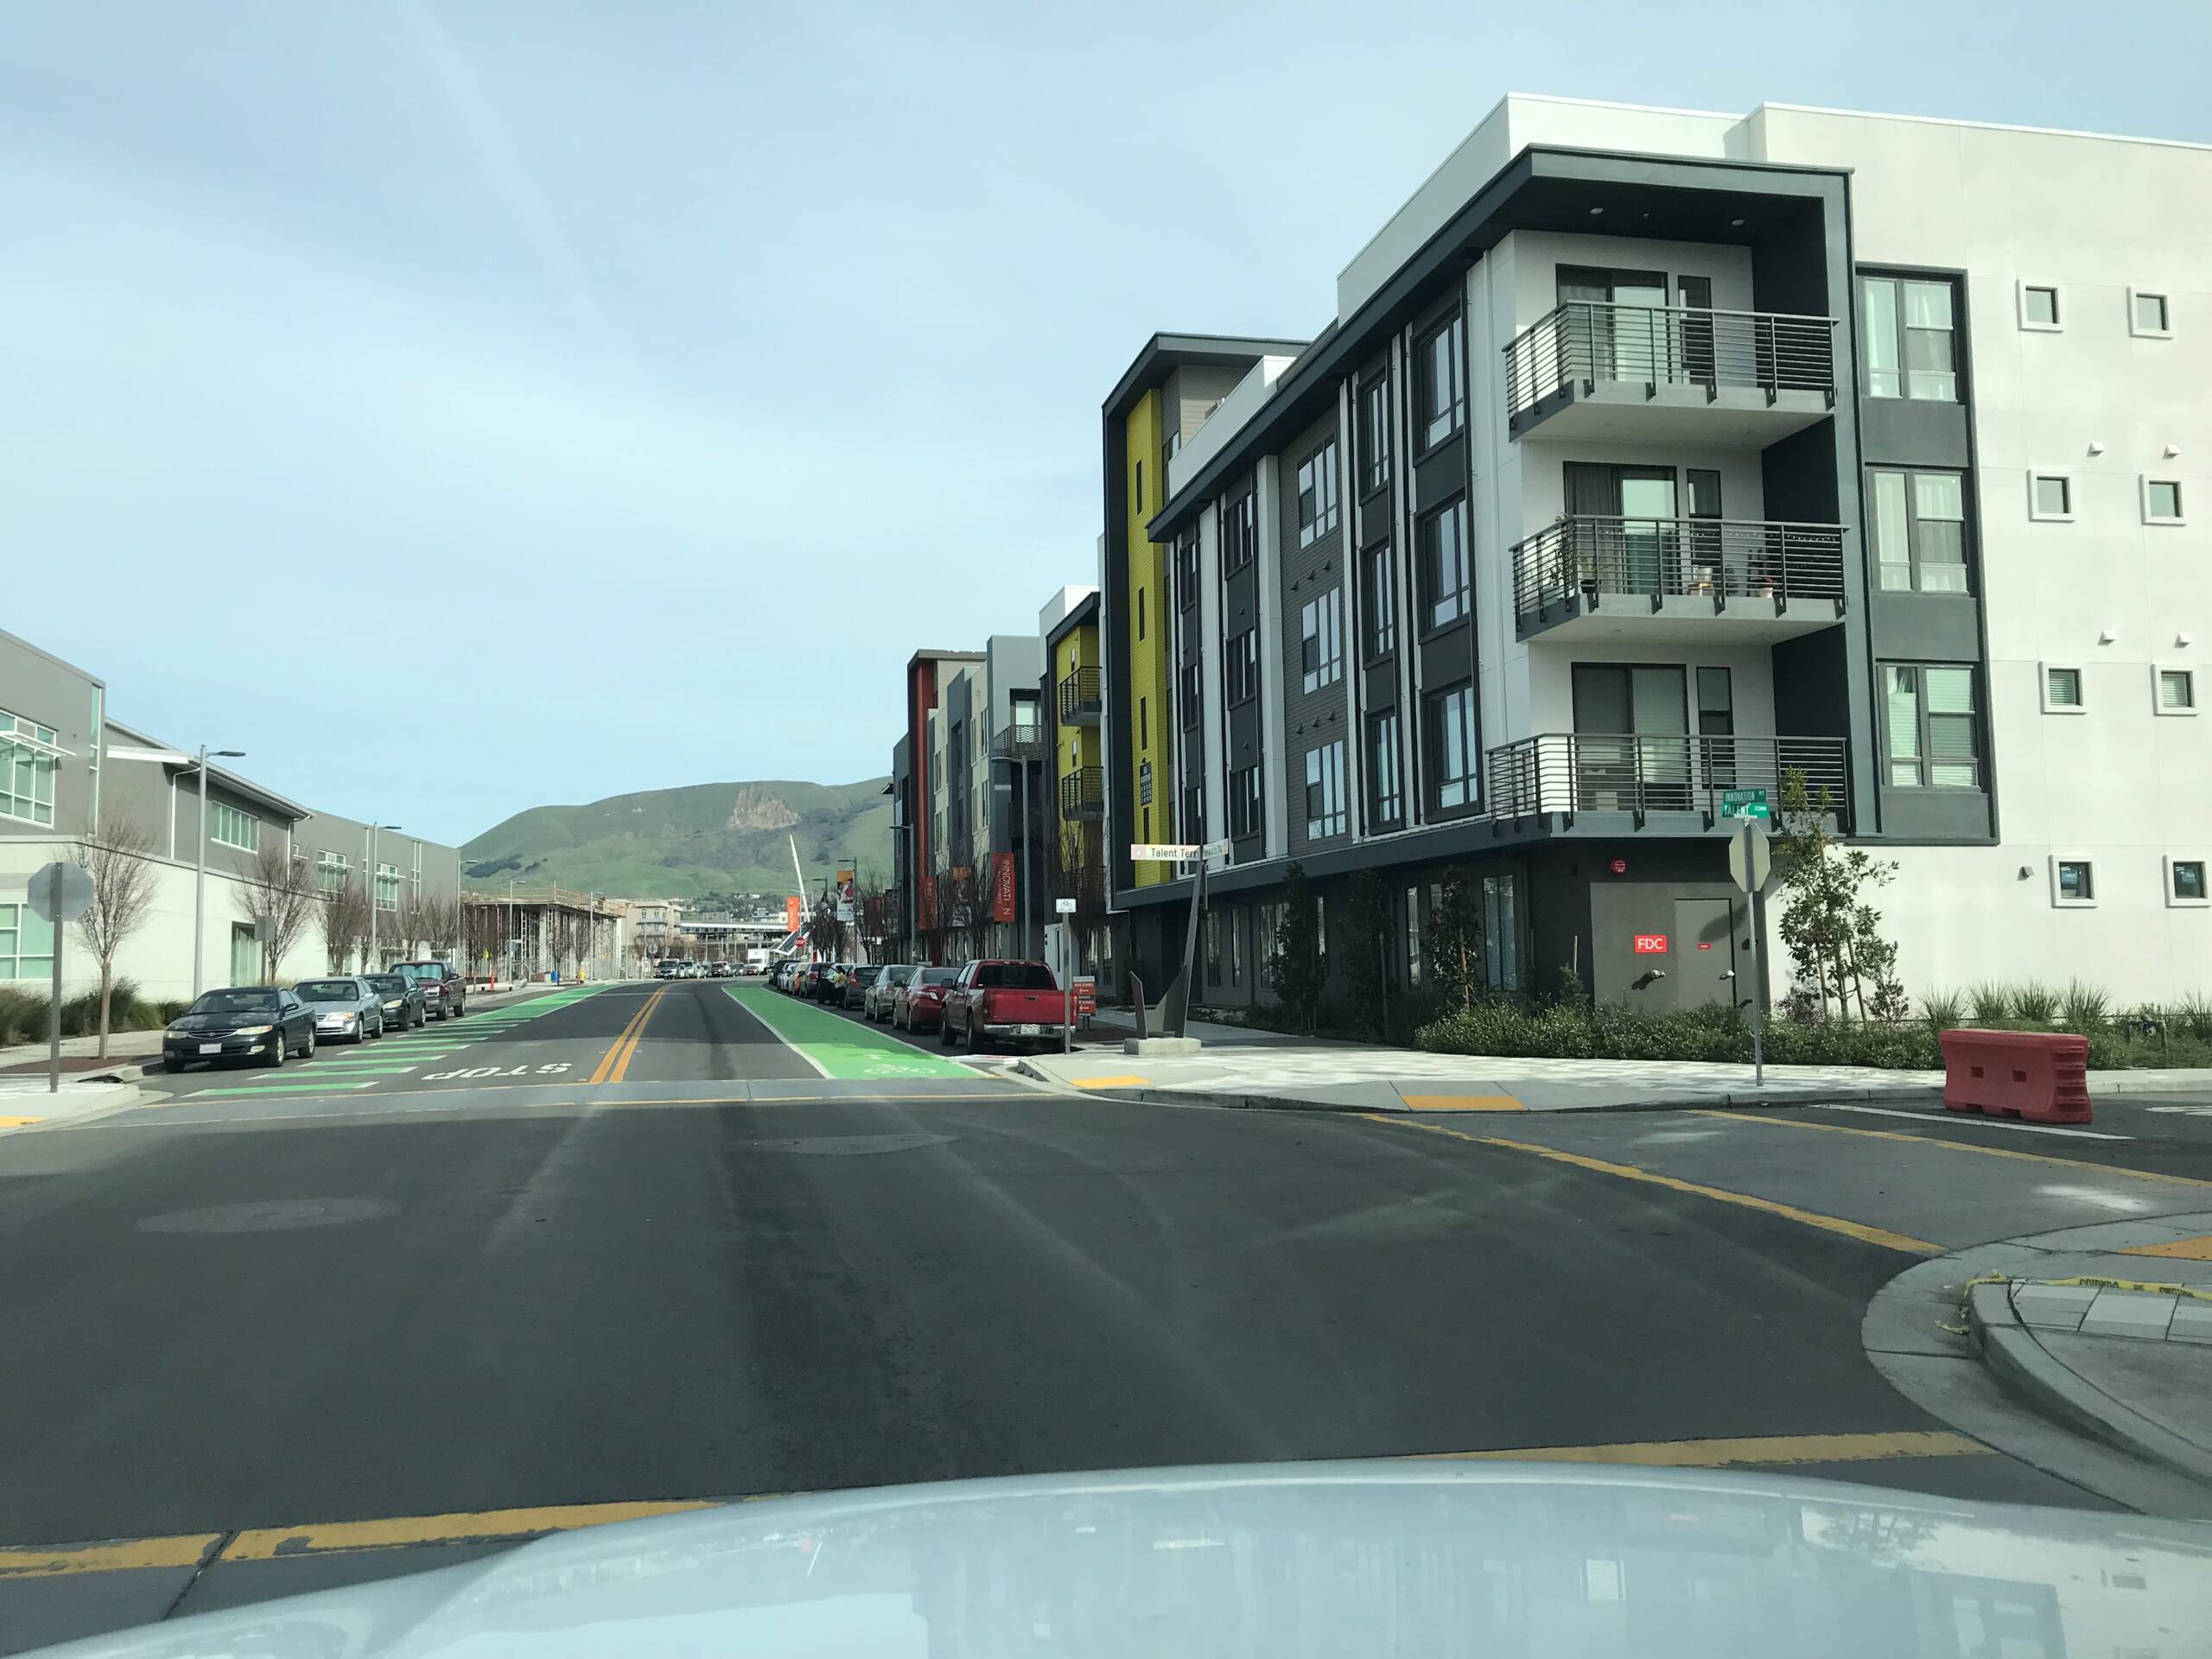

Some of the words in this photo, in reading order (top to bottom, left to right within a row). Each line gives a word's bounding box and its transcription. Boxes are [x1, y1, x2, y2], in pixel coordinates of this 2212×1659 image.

[1725, 791, 1755, 802] INNOVATION
[1724, 804, 1749, 816] TALENT
[1150, 848, 1178, 858] Talent
[1179, 849, 1198, 858] Terr
[1002, 858, 1011, 916] INNOVATIN
[1637, 938, 1664, 950] FDC
[421, 1063, 573, 1080] STOP
